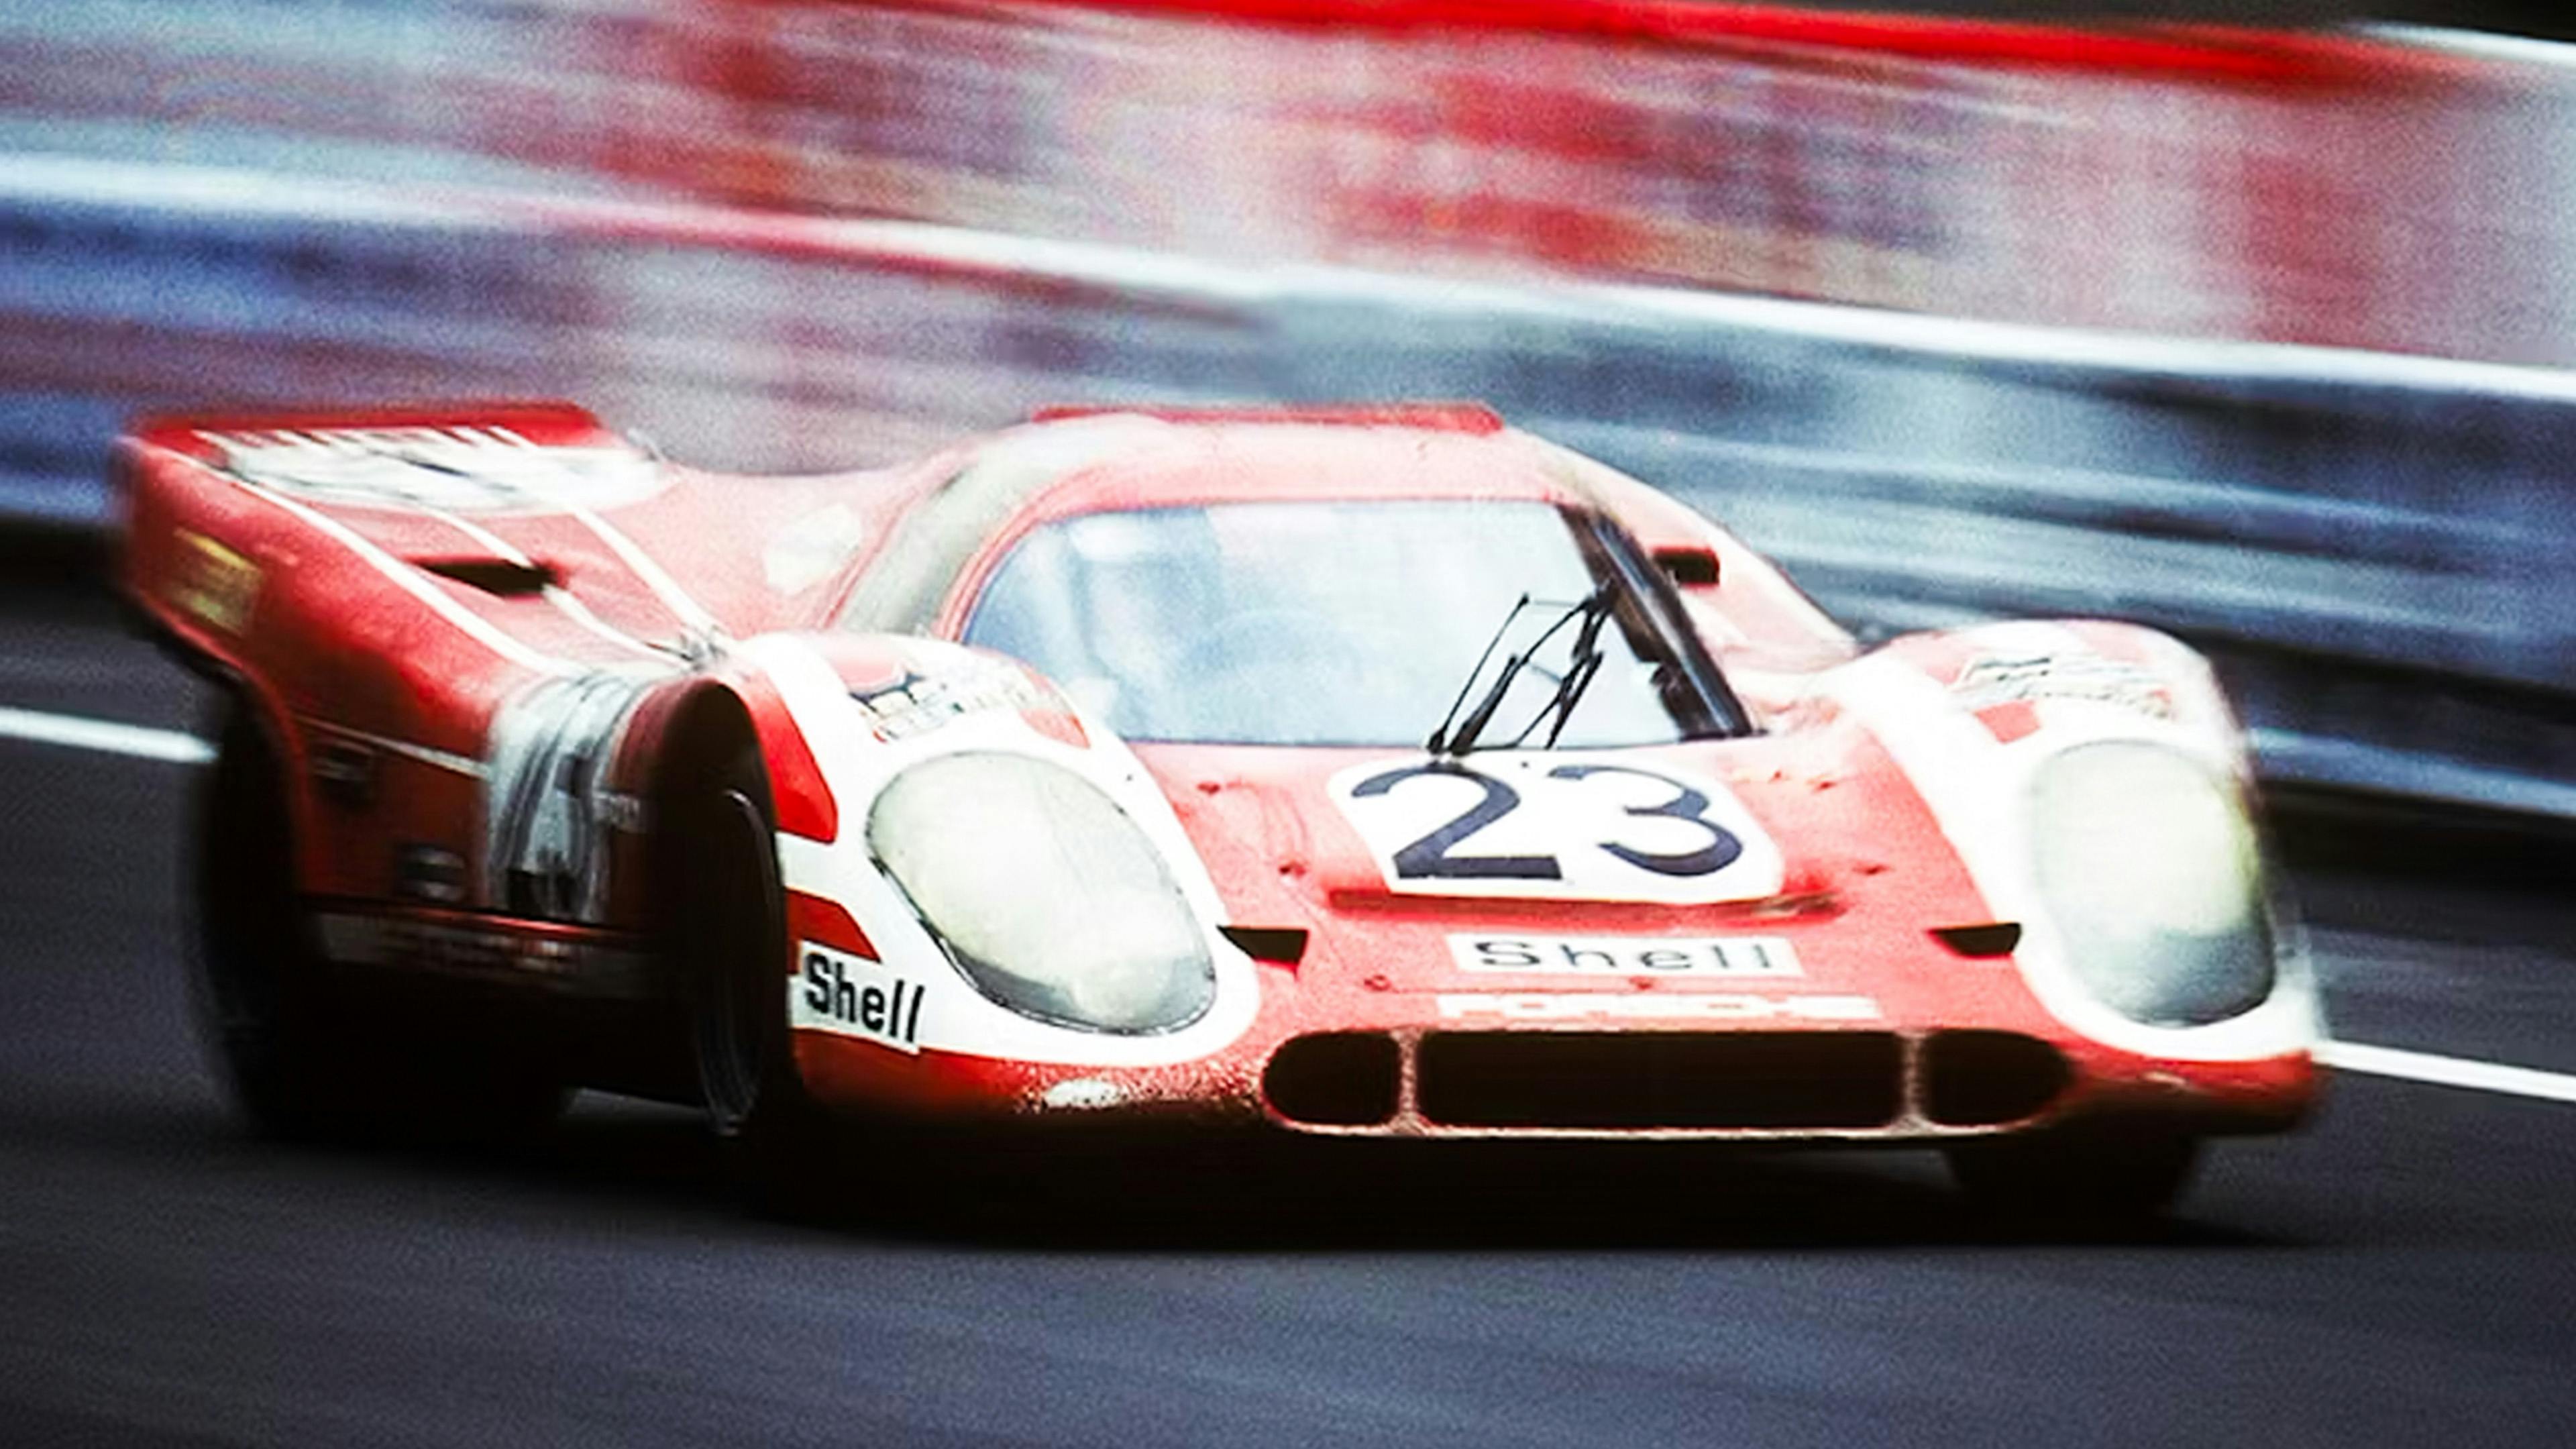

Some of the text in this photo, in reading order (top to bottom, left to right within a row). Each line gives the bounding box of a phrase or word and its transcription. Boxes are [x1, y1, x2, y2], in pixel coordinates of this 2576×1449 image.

[1351, 763, 1743, 880] 23
[806, 952, 924, 1042] Shell
[1474, 941, 1773, 970] Shell
